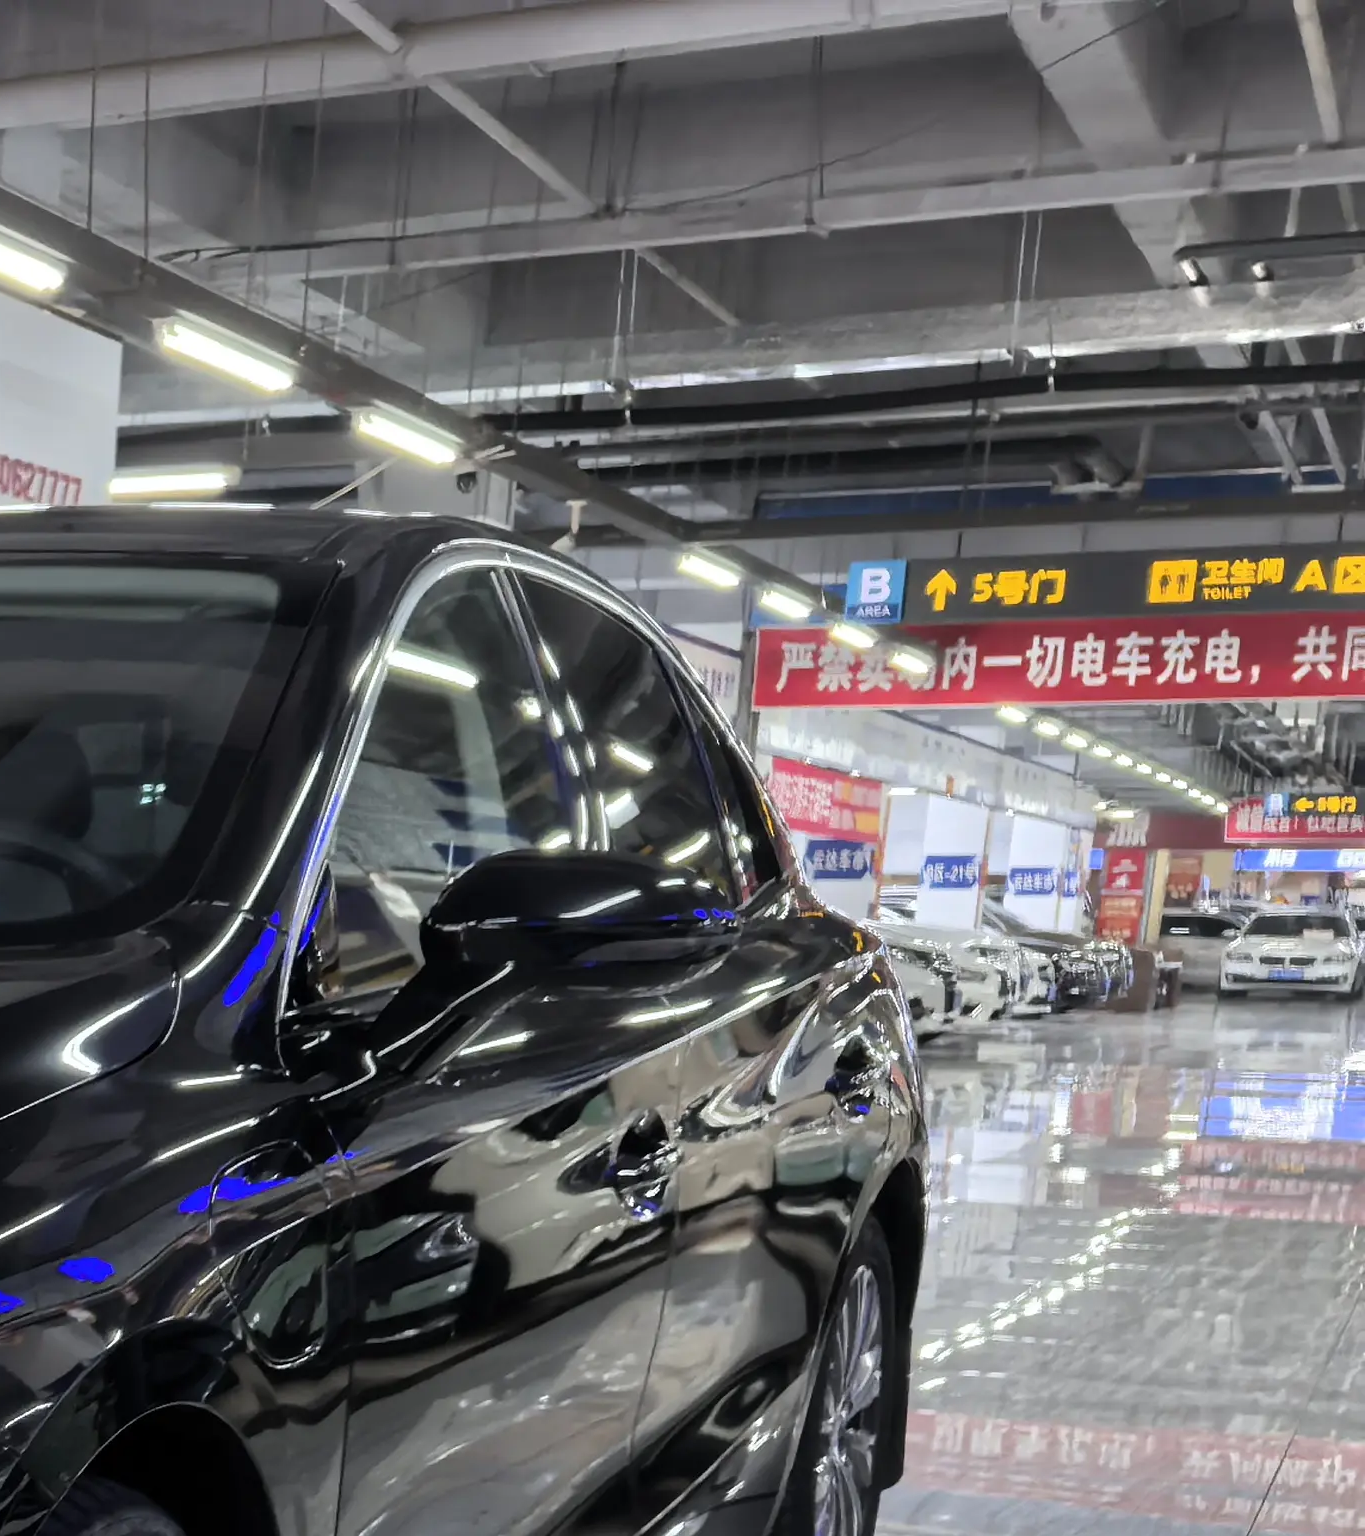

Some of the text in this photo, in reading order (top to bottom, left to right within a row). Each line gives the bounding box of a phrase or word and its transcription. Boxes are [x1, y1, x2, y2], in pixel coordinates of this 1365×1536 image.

[860, 567, 892, 604] B
[1201, 556, 1285, 586] 卫生间
[971, 568, 1068, 605] 5号门
[1202, 585, 1253, 601] TOILET
[855, 605, 892, 618] AREA
